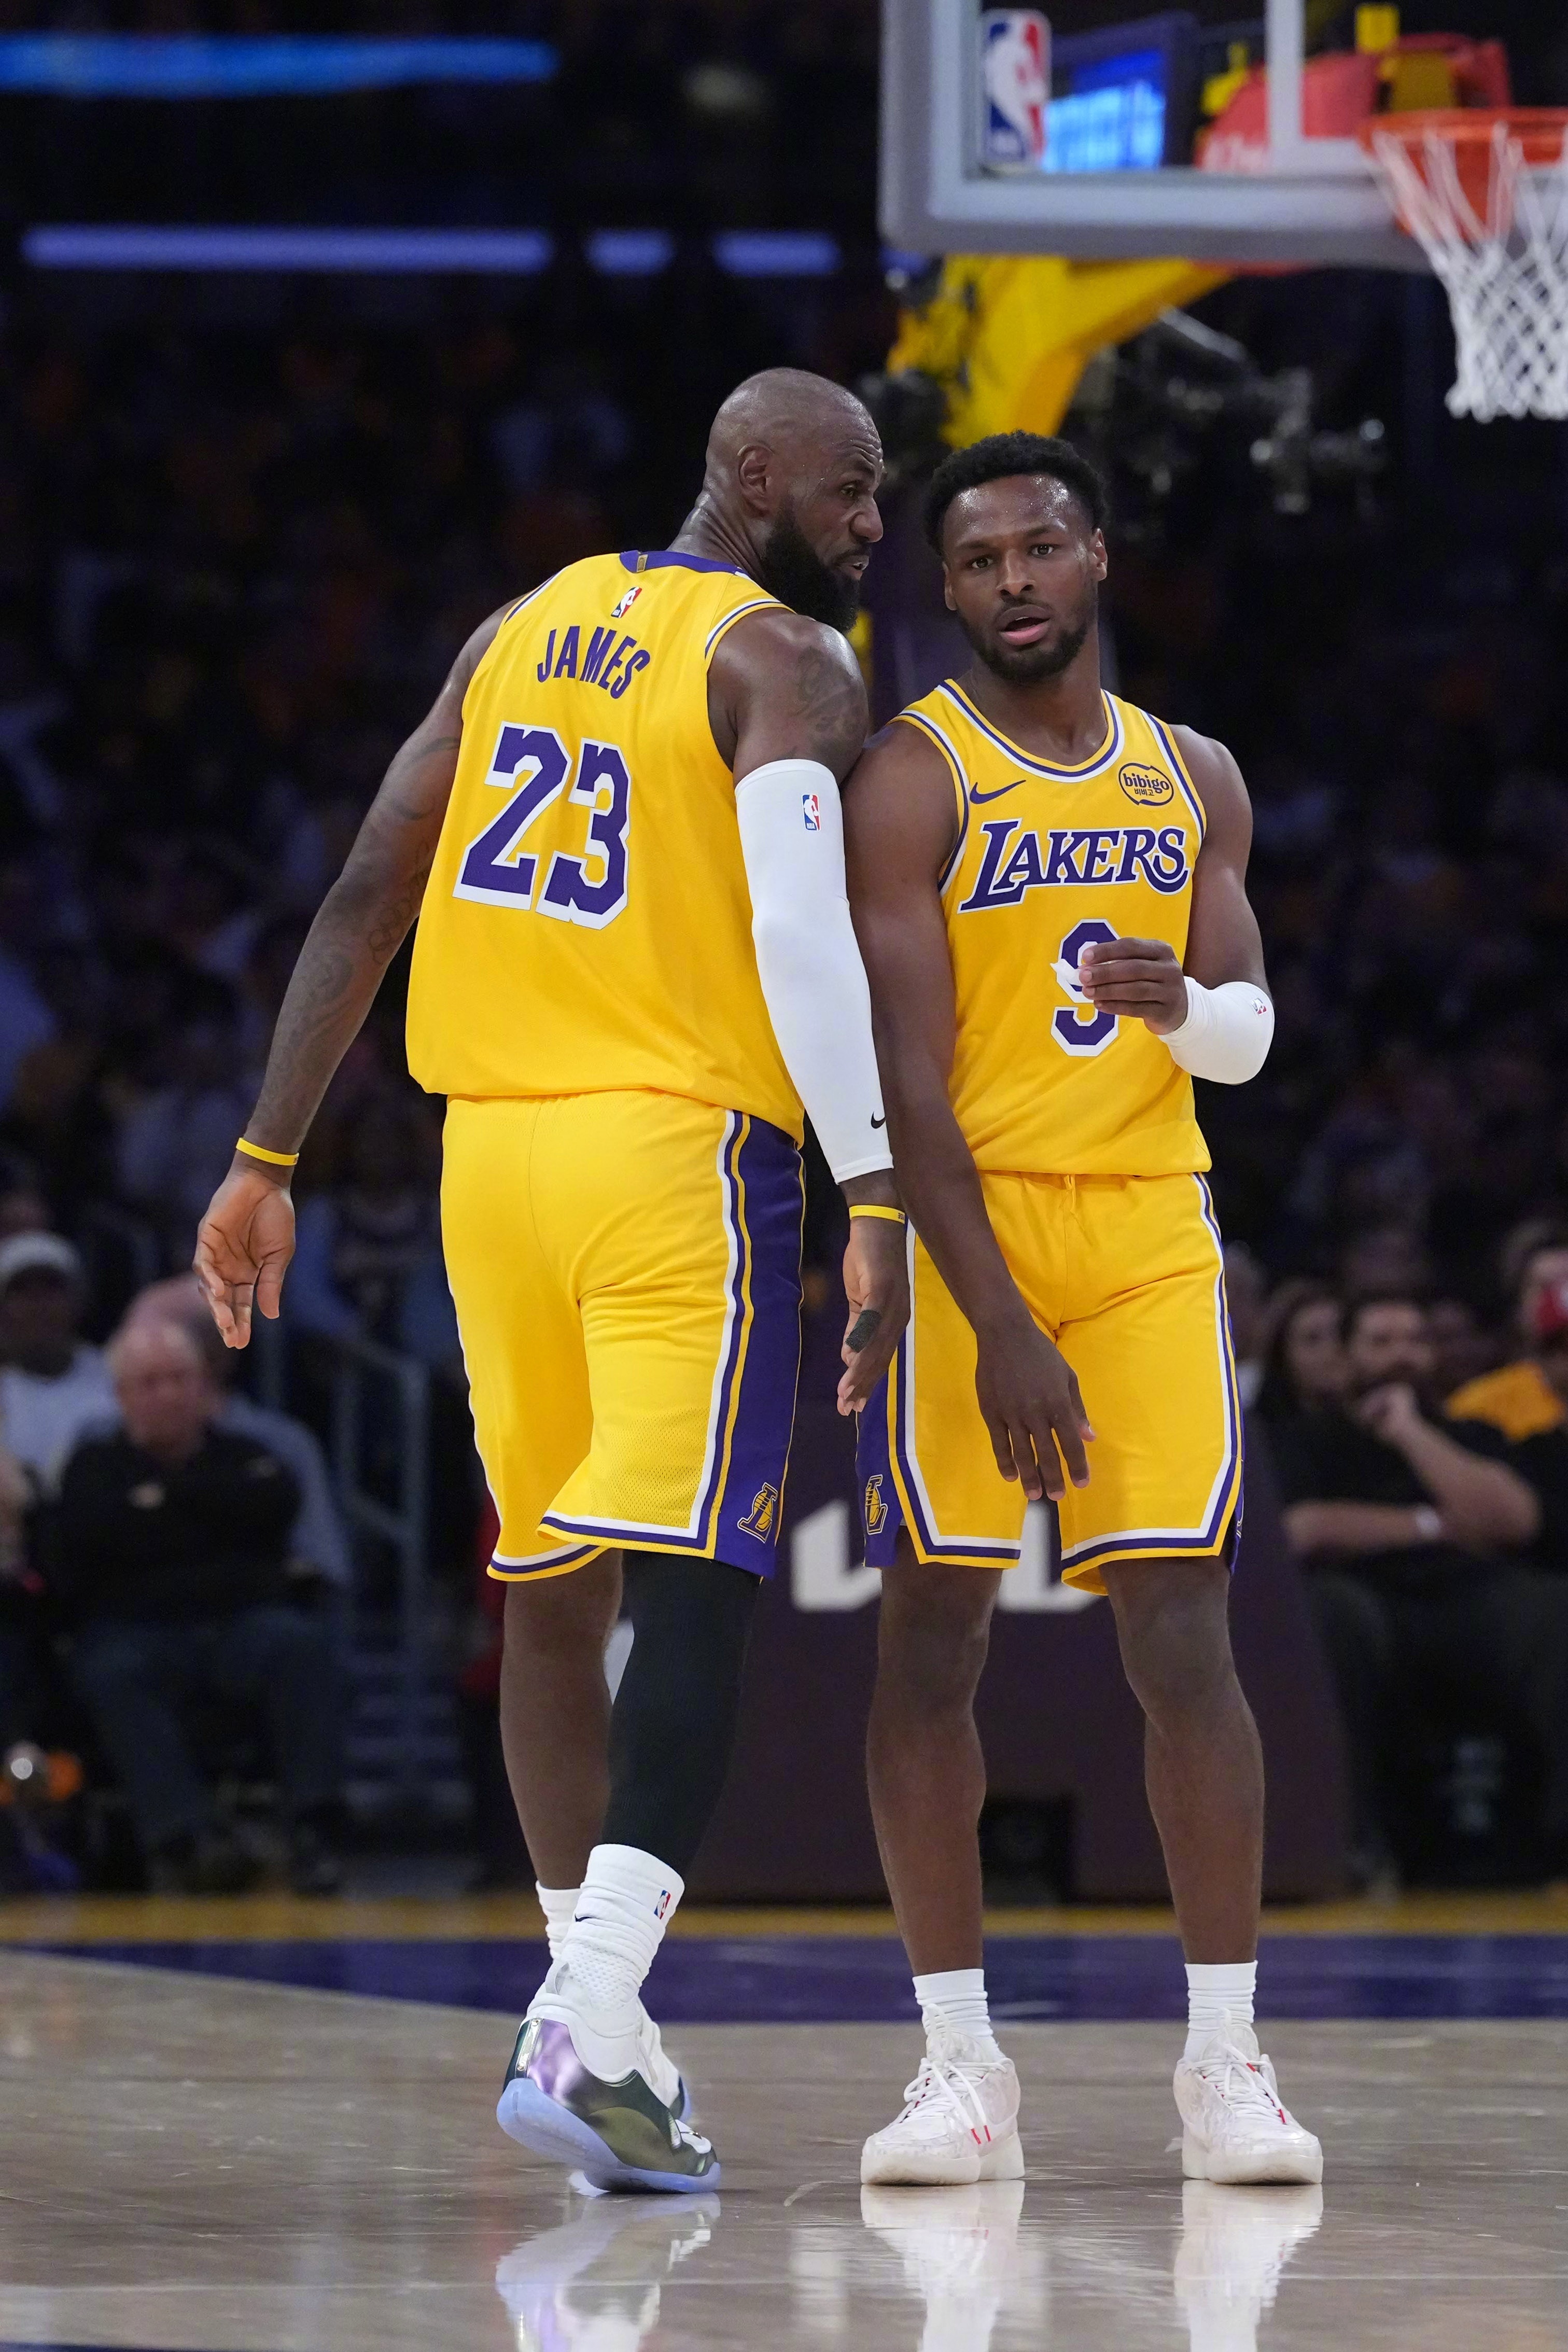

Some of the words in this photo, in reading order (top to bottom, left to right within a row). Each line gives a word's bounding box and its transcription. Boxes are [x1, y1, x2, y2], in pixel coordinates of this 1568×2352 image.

[537, 625, 651, 699] JAMES
[453, 721, 631, 930] 23
[1123, 773, 1170, 793] bibigo
[958, 818, 1191, 914] LAKERS
[1051, 919, 1122, 1057] 9
